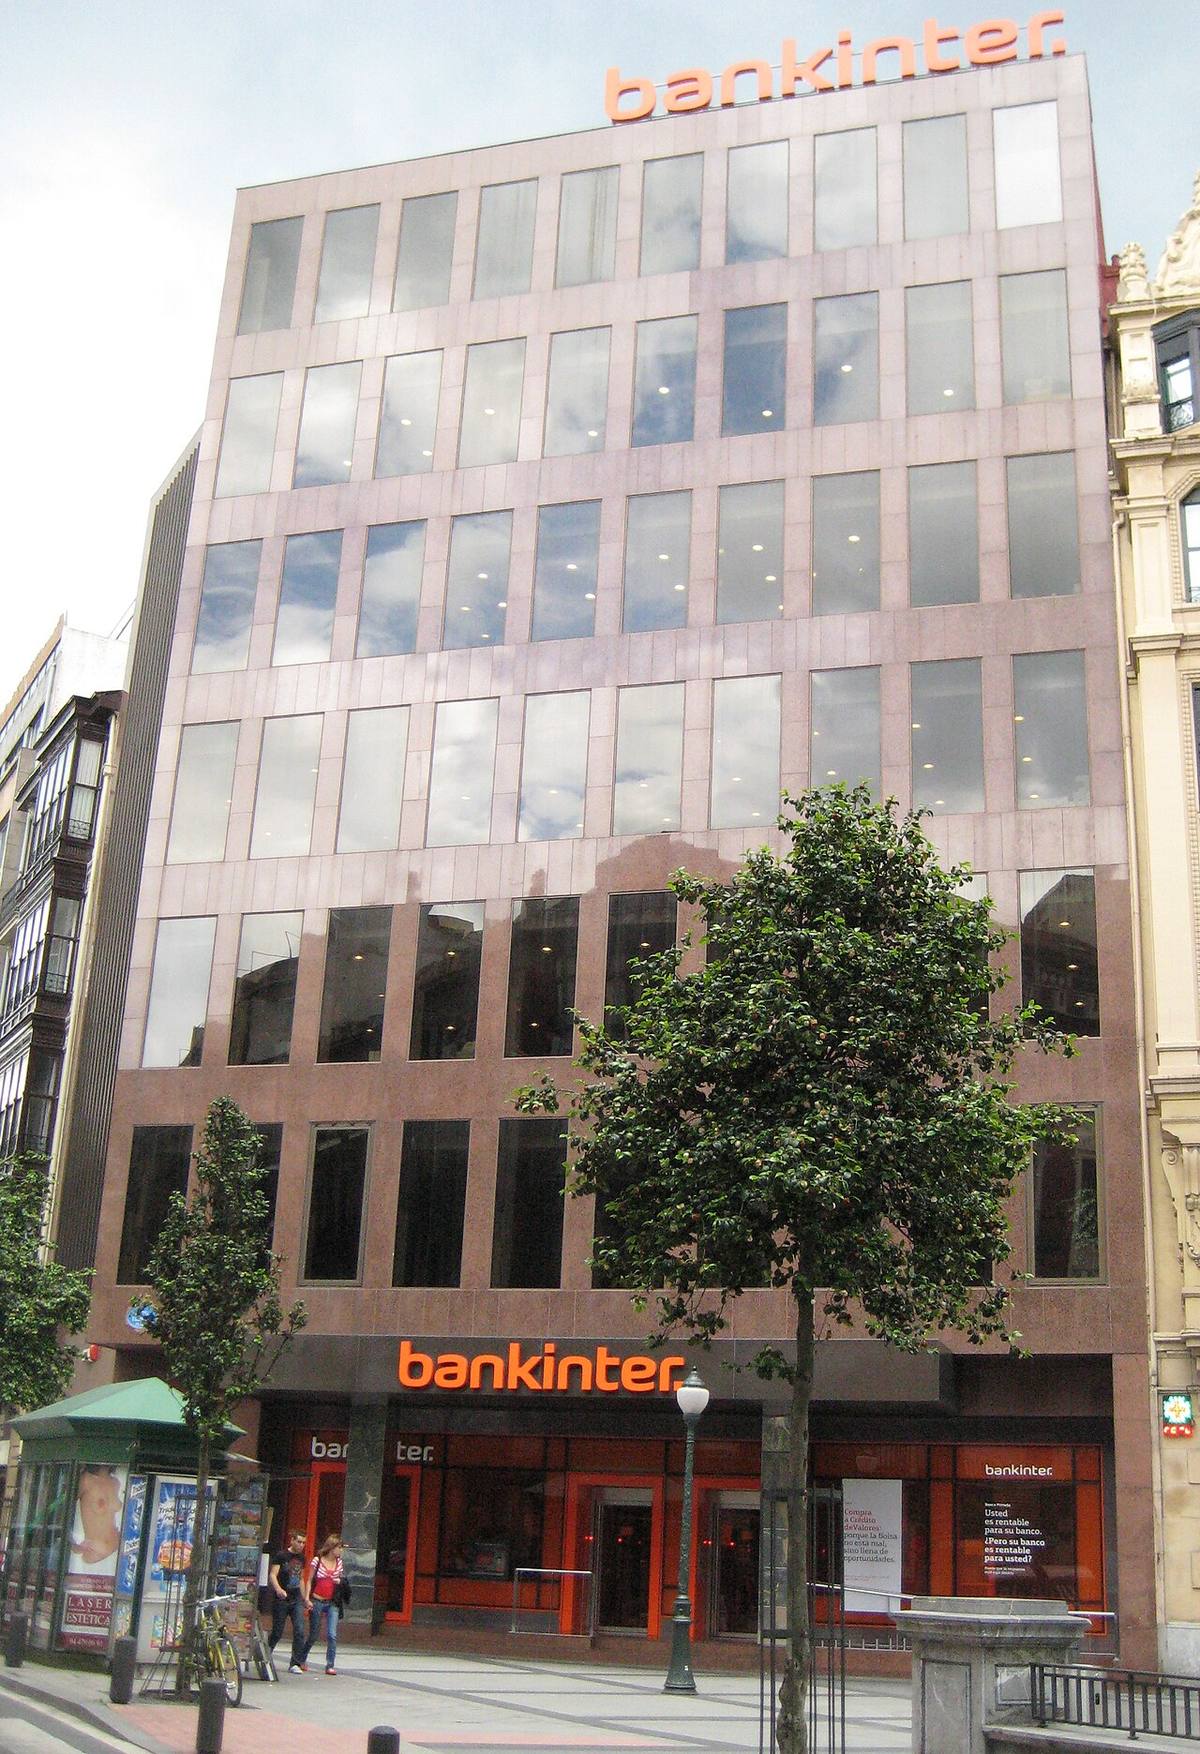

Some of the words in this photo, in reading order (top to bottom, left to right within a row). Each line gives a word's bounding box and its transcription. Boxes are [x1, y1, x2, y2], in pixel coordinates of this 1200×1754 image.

[604, 10, 1066, 125] bankinter.
[398, 1340, 686, 1393] bankinter.
[985, 1464, 1053, 1476] bankinter.
[985, 1509, 1008, 1517] Usted
[995, 1518, 1030, 1526] rentable
[985, 1527, 1003, 1536] para
[1016, 1527, 1042, 1535] banco.
[985, 1537, 1008, 1545] ¿Pero
[1020, 1538, 1045, 1546] banco
[995, 1546, 1031, 1555] rentable
[985, 1554, 1004, 1563] para
[1005, 1555, 1032, 1563] usted?
